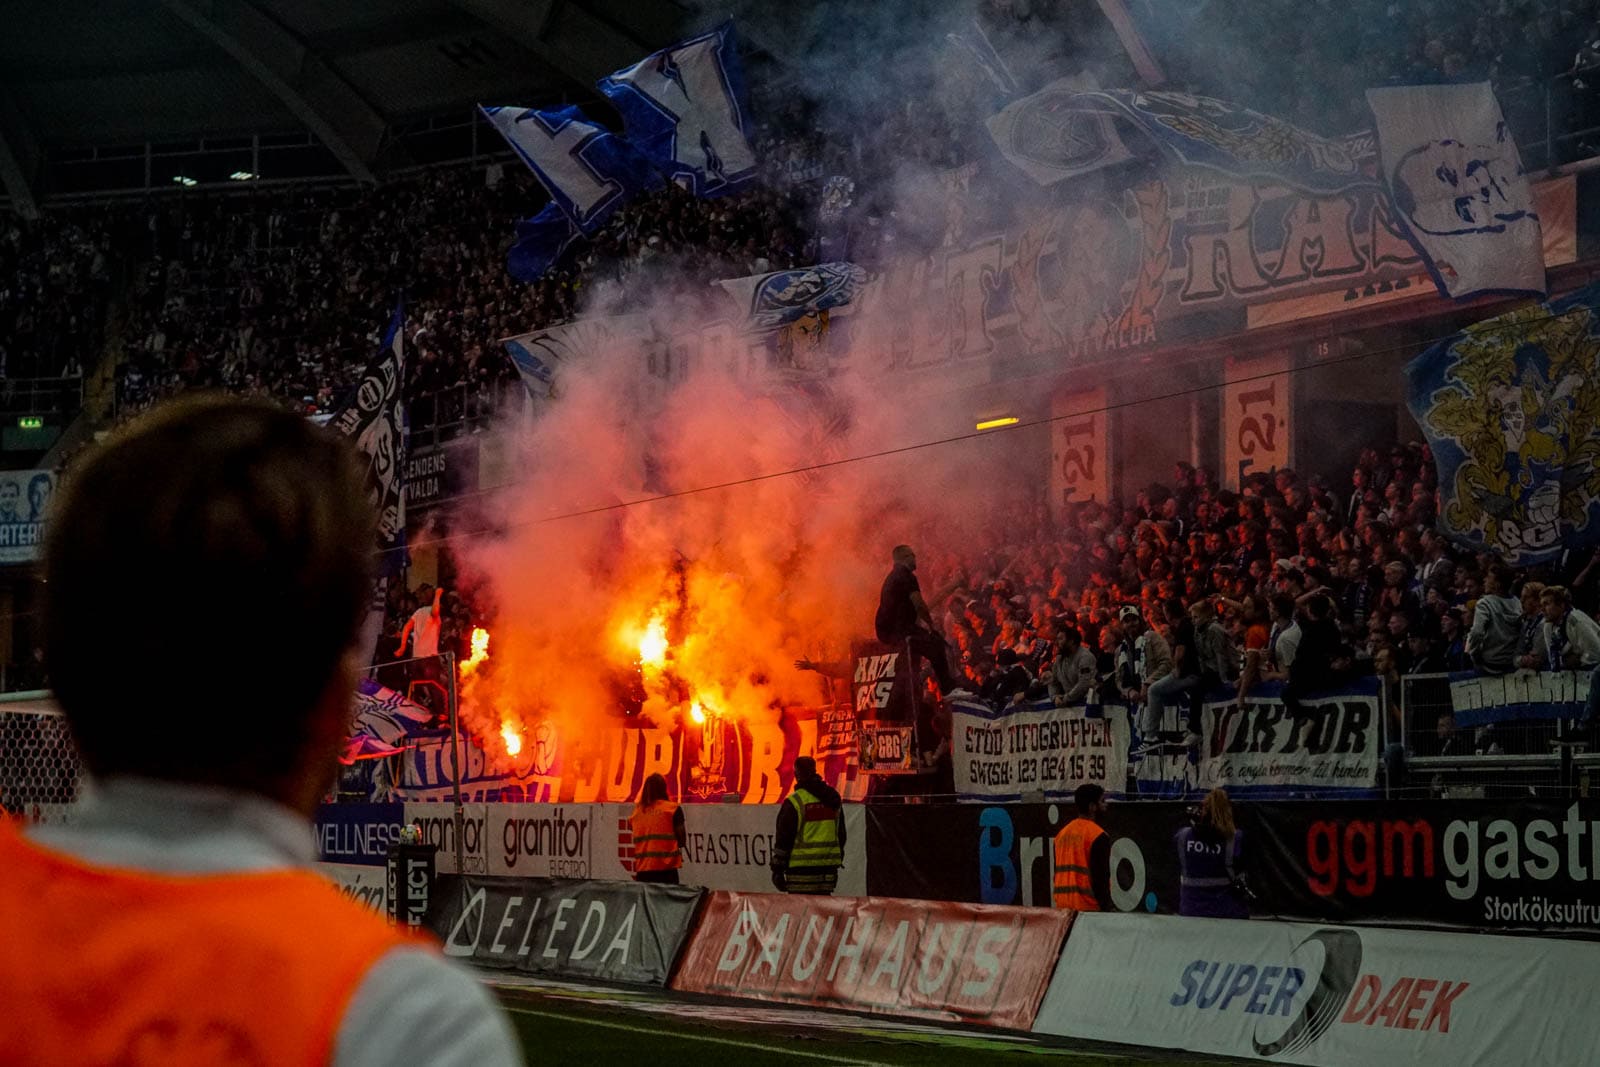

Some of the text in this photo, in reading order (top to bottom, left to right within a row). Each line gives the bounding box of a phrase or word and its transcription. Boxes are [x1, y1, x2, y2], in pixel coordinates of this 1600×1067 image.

[878, 734, 900, 760] GBG
[966, 718, 1112, 756] STÖD TIFOGRUPPEN
[1209, 701, 1371, 758] VIKTOR
[970, 755, 1105, 785] SWISH: 123 024 15 39
[503, 807, 587, 868] granitor
[1305, 818, 1436, 897] ggm
[406, 858, 429, 932] ELECT
[715, 910, 1013, 999] BAUHAUS
[1169, 958, 1307, 1018] SUPER
